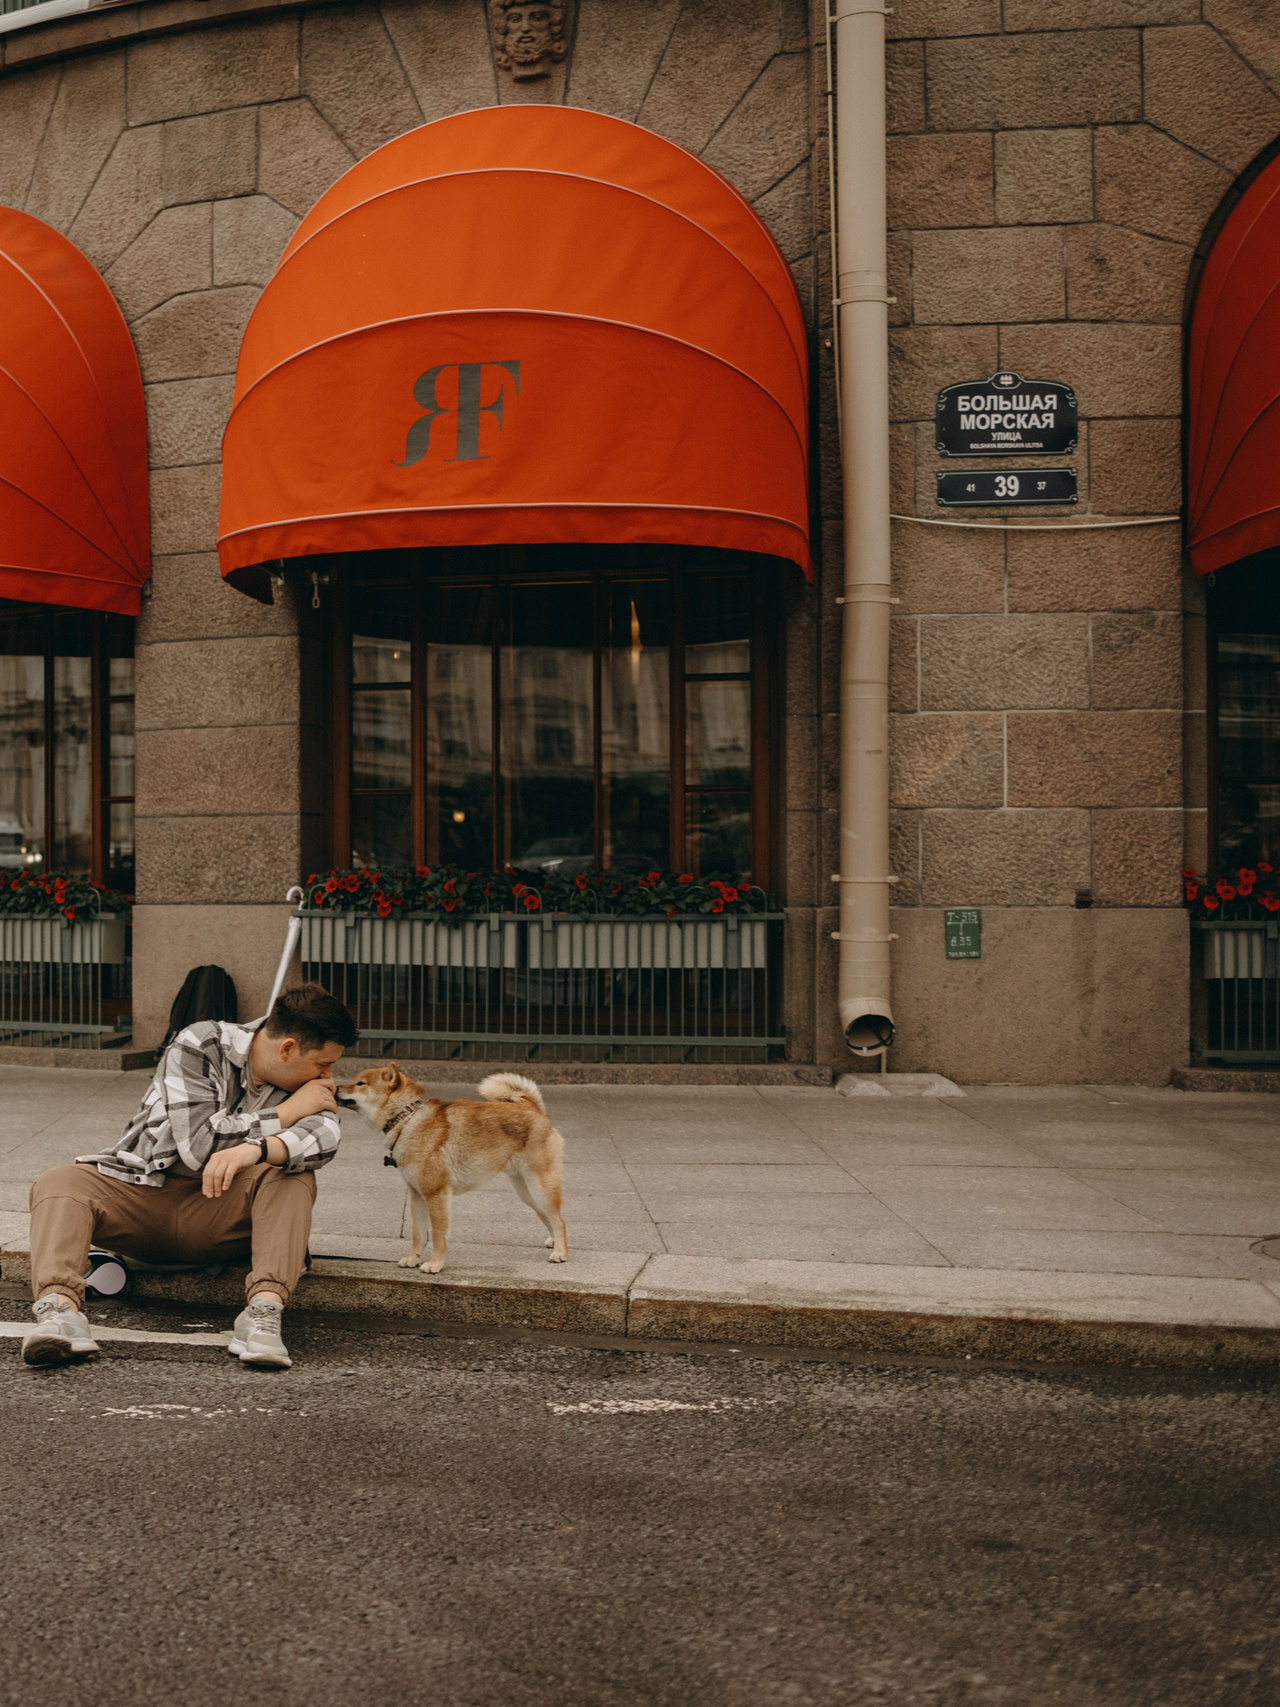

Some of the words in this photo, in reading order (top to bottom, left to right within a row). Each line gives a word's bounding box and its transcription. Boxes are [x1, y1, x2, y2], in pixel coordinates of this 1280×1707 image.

[957, 394, 1057, 411] БОЛЬШАЯ
[960, 413, 1055, 430] МОРСКАЯ
[991, 432, 1022, 442] УЛИЦА
[966, 483, 976, 493] 41
[994, 475, 1020, 497] 39
[1036, 481, 1047, 491] 37
